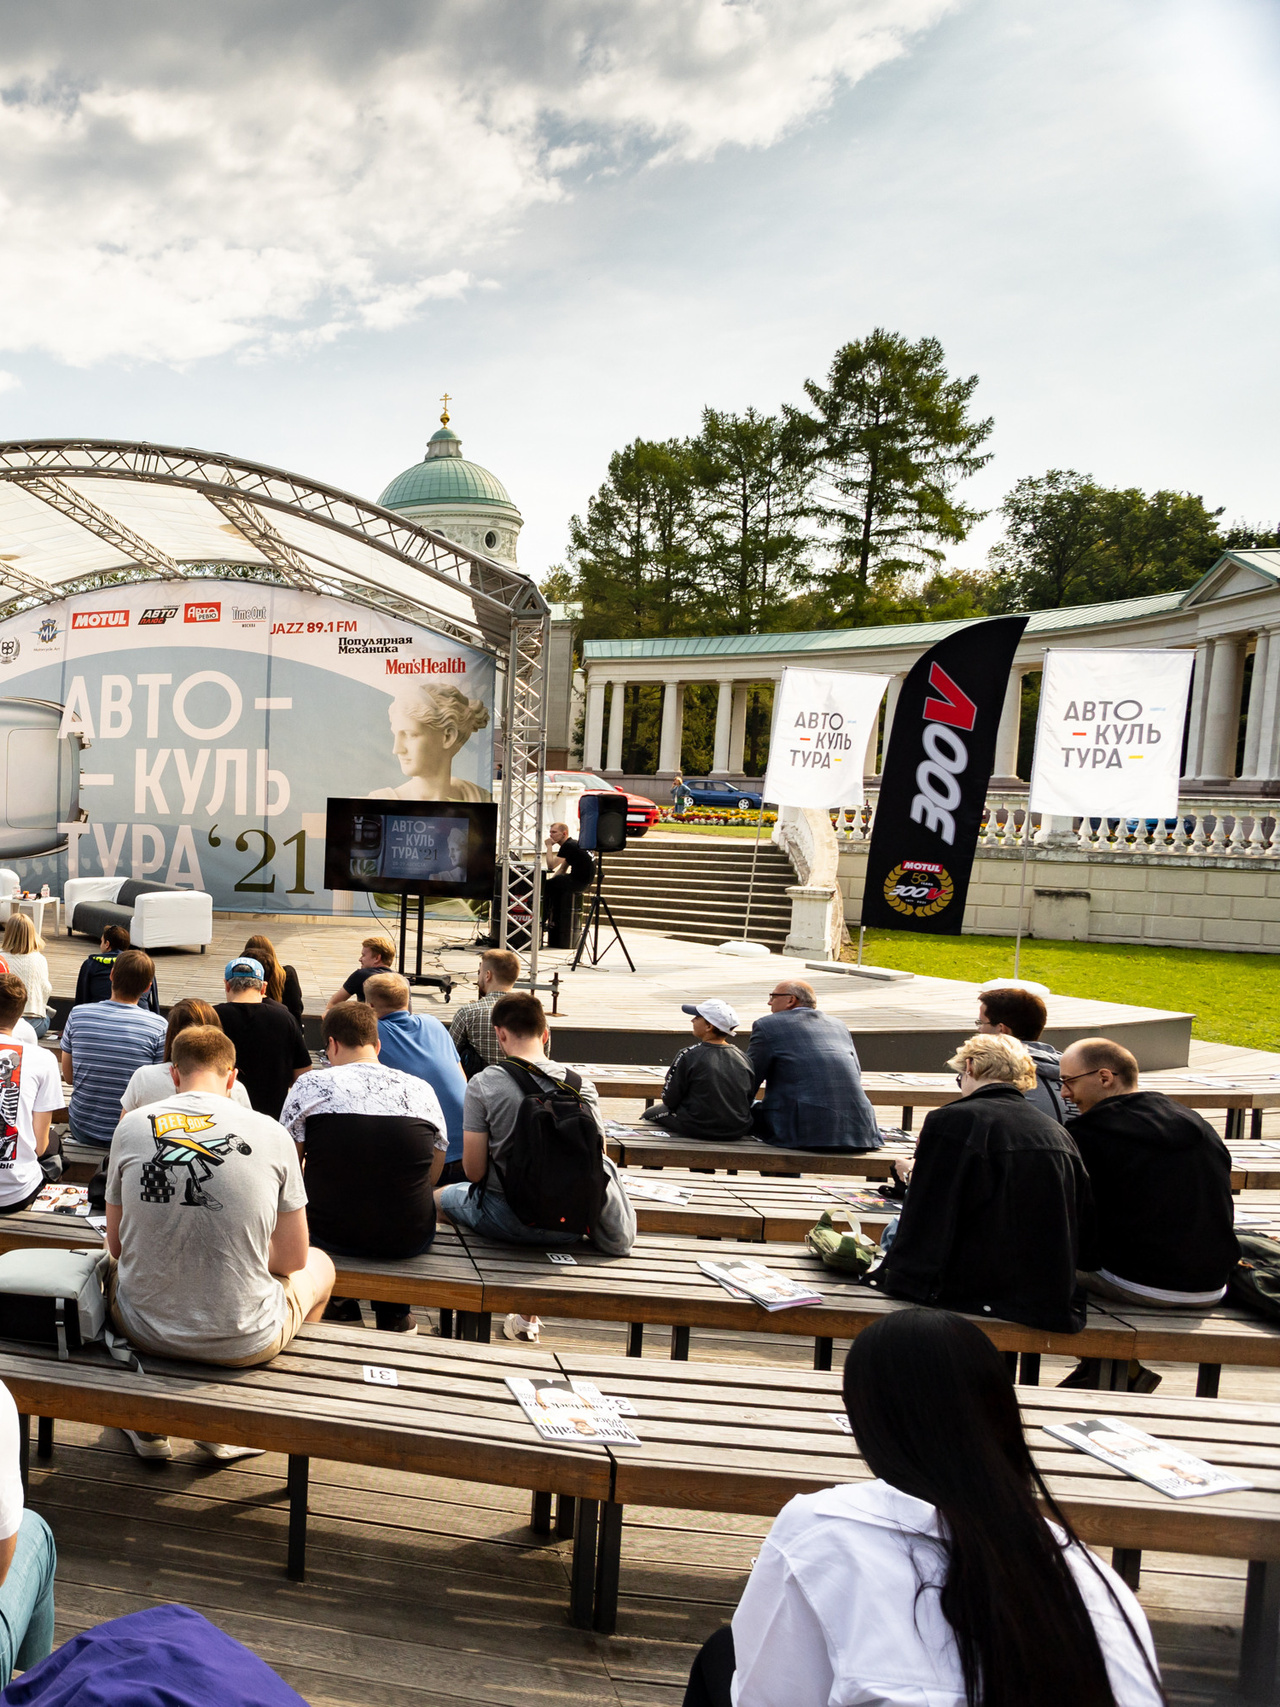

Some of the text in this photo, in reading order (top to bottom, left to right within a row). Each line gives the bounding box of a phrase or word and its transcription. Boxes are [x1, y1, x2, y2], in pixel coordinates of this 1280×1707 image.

[74, 612, 127, 627] MOTUL
[143, 609, 176, 618] АВТО
[270, 621, 357, 635] JAZZ 89.1 FM
[338, 637, 413, 647] Популярная
[338, 645, 399, 655] Механика
[910, 661, 978, 846] 300V
[391, 846, 419, 860] ТУРА
[904, 862, 941, 873] MOTUL
[911, 872, 929, 885] 50
[889, 885, 949, 900] 300V
[549, 1254, 573, 1262] 30
[370, 1369, 391, 1381] 31
